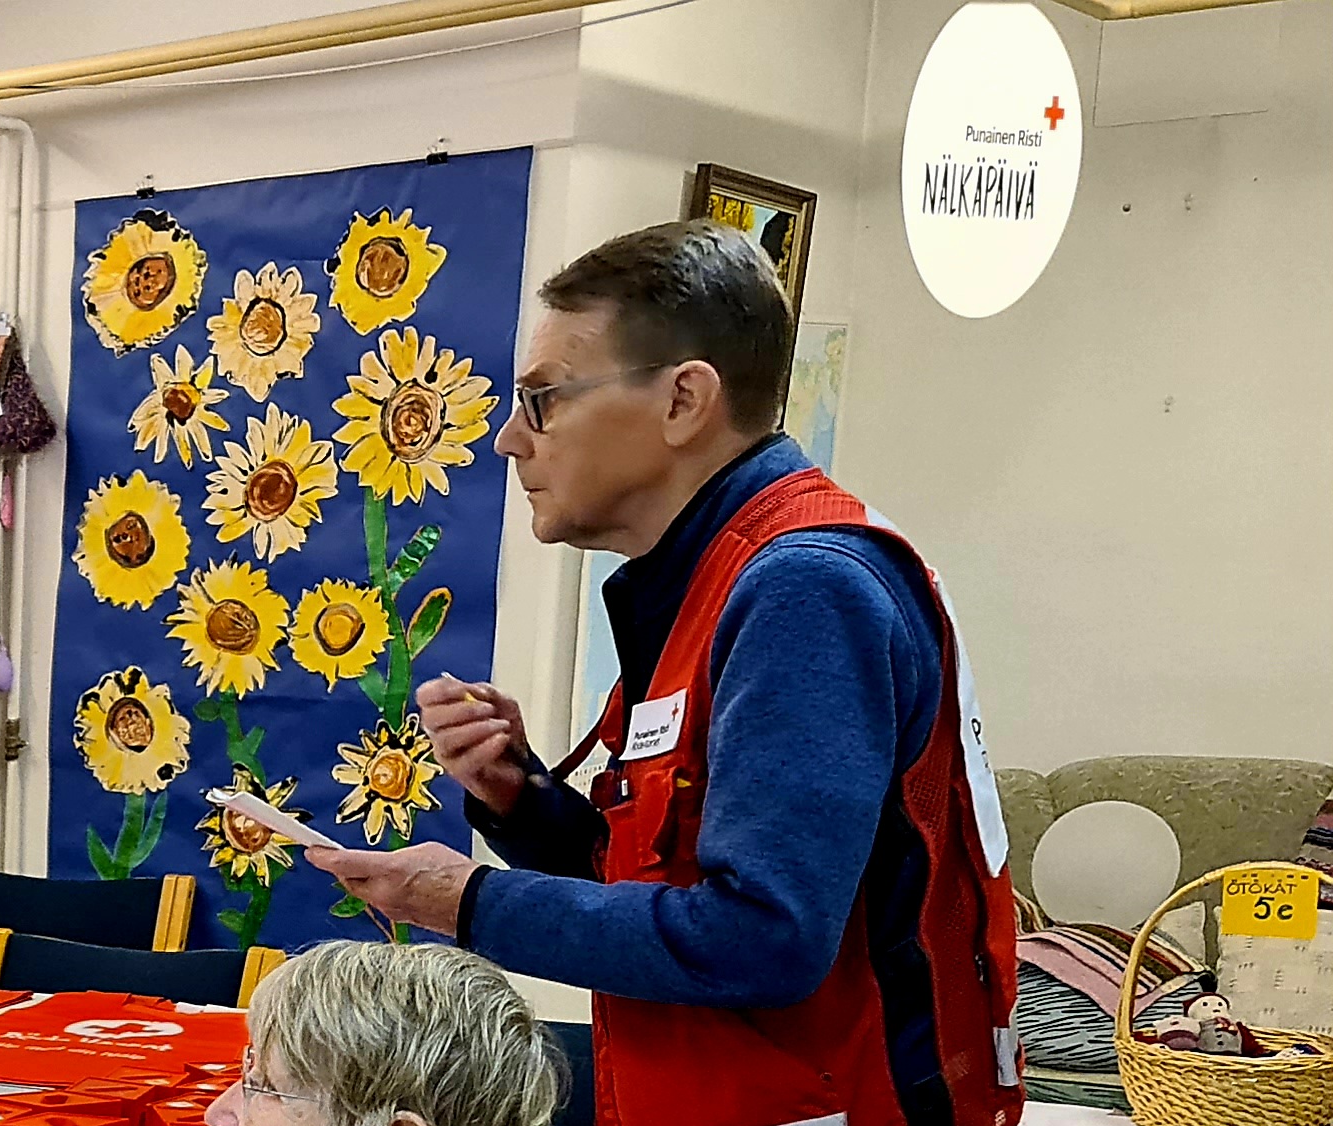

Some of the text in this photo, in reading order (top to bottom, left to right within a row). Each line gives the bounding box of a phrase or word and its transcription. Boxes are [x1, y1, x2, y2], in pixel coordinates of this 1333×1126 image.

[966, 125, 1043, 147] Punainen Risti
[922, 154, 1038, 220] NÄLKÄPÄIVÄ
